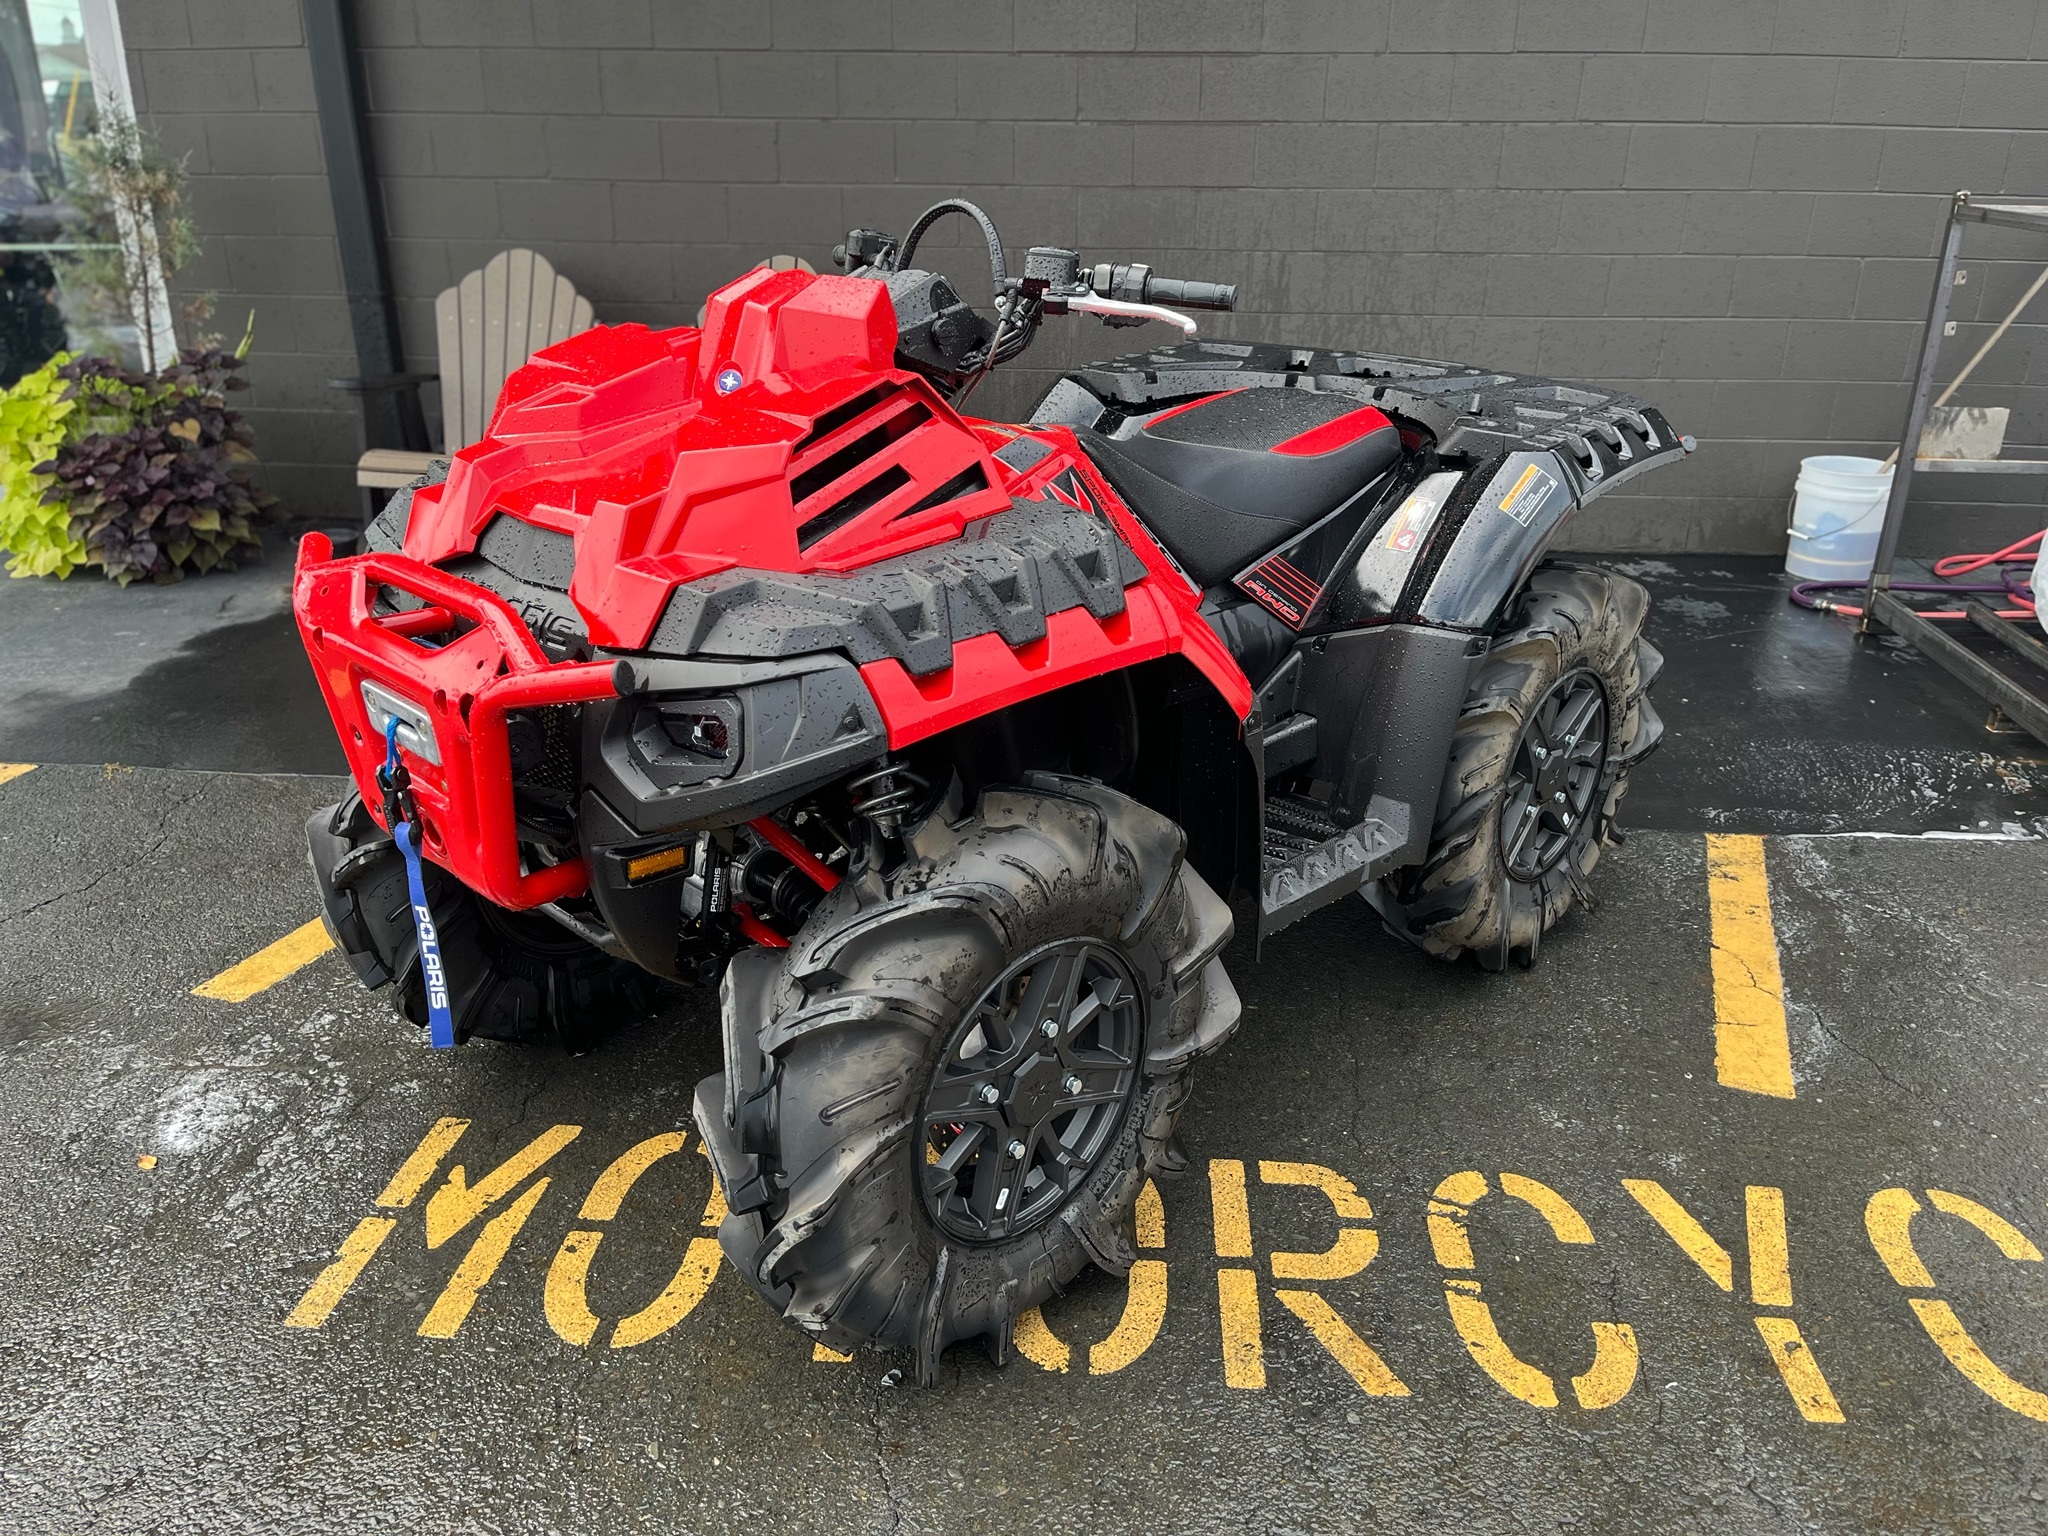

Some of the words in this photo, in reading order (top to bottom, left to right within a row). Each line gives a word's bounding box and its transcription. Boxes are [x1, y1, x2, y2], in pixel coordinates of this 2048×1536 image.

[1081, 469, 1134, 550] SPORTSMAN
[1244, 580, 1301, 622] AWD
[710, 867, 721, 912] POLARIS
[414, 905, 448, 1010] POLARIS
[283, 1116, 2048, 1424] MOORCYC
